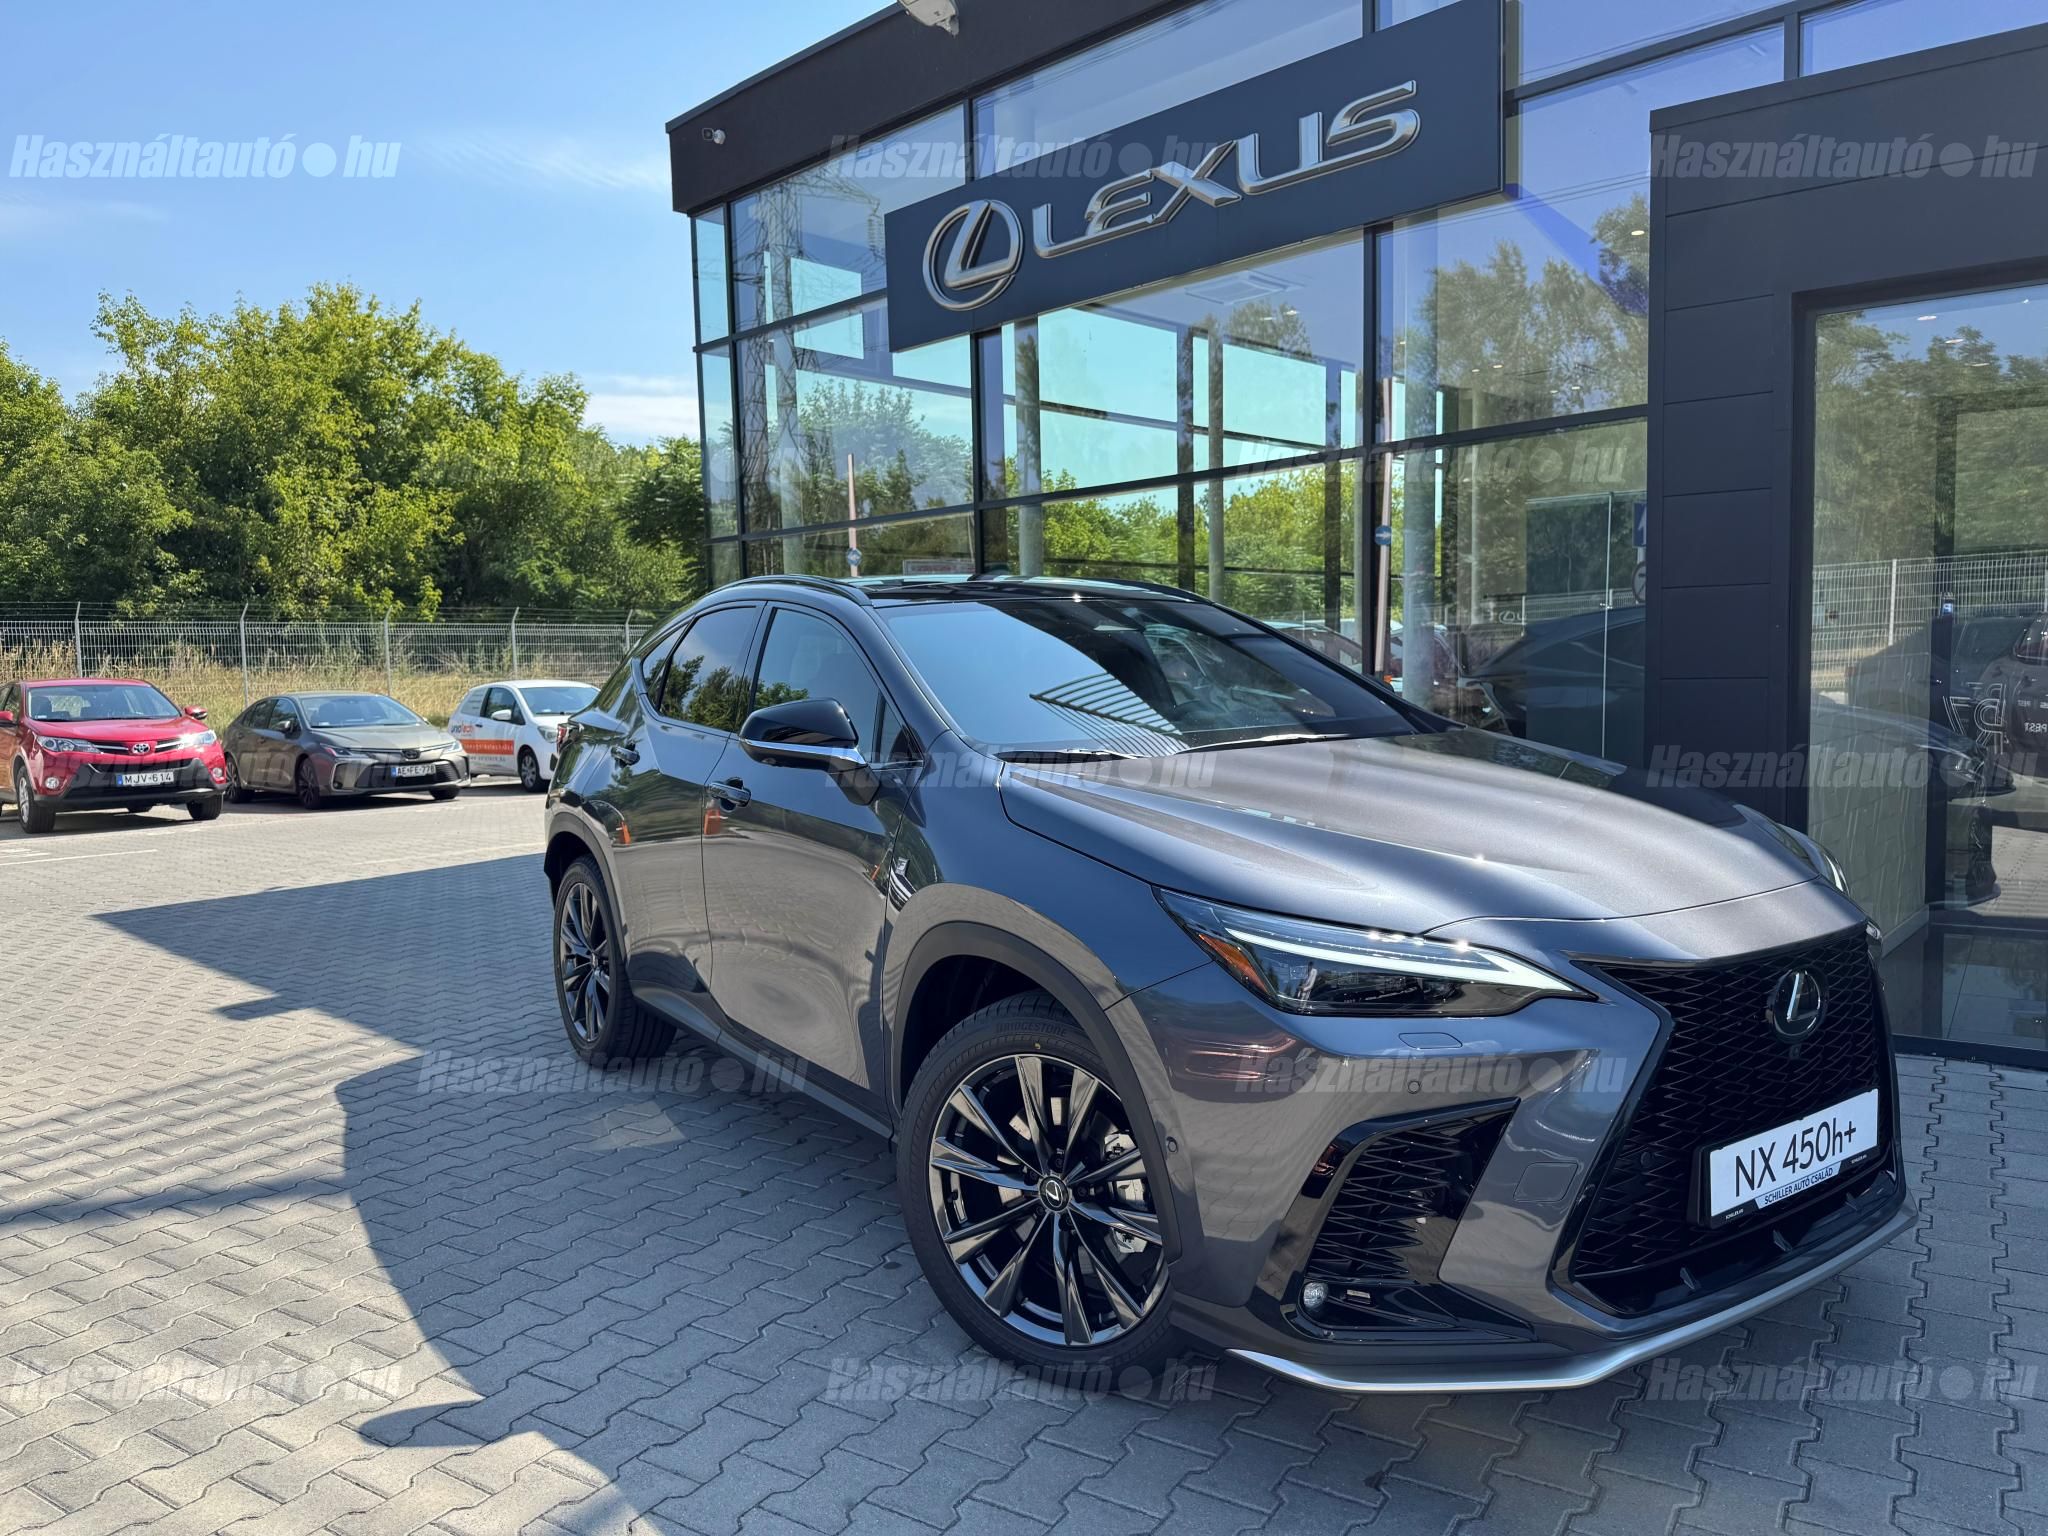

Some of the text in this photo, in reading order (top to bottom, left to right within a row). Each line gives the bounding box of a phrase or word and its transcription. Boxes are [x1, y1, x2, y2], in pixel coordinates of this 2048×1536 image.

[1032, 80, 1422, 260] LEXUS
[125, 772, 171, 785] MJV-614
[1735, 1117, 1857, 1198] NX 450h+
[1764, 1167, 1834, 1205] SCHILLER AUTÓ CSALÁD
